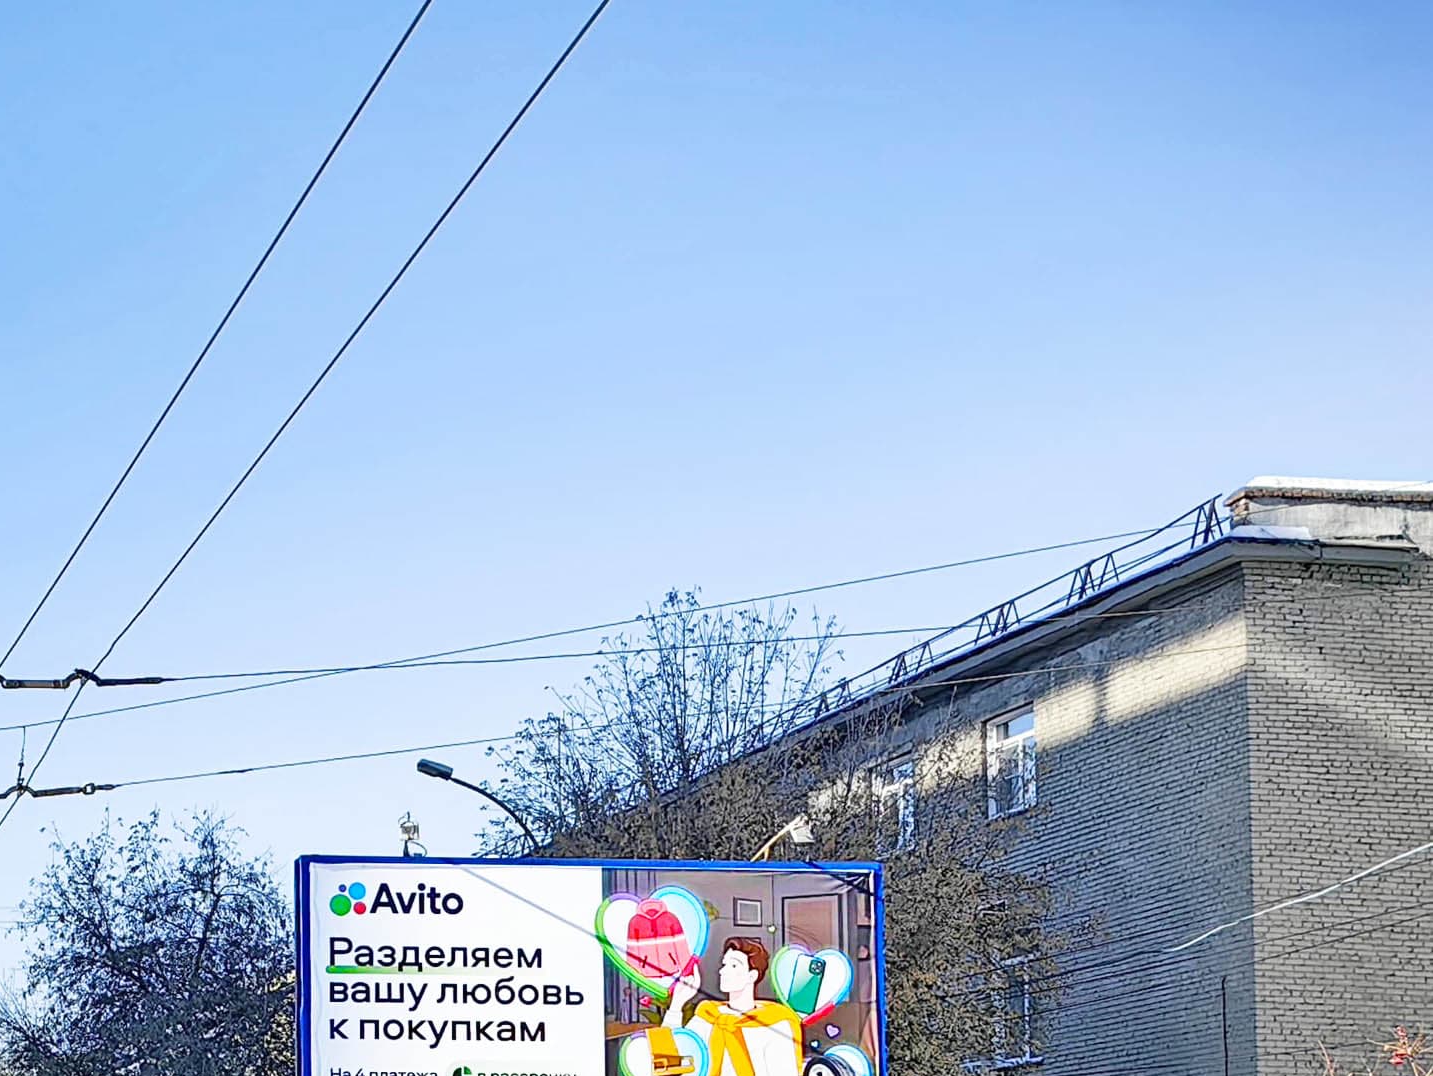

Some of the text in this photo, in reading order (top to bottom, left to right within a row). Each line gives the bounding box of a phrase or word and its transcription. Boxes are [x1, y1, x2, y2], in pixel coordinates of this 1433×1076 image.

[370, 883, 464, 915] Avito
[329, 937, 542, 972] Разделяем
[329, 976, 585, 1012] вашу любовь
[329, 1018, 546, 1049] к покупкам
